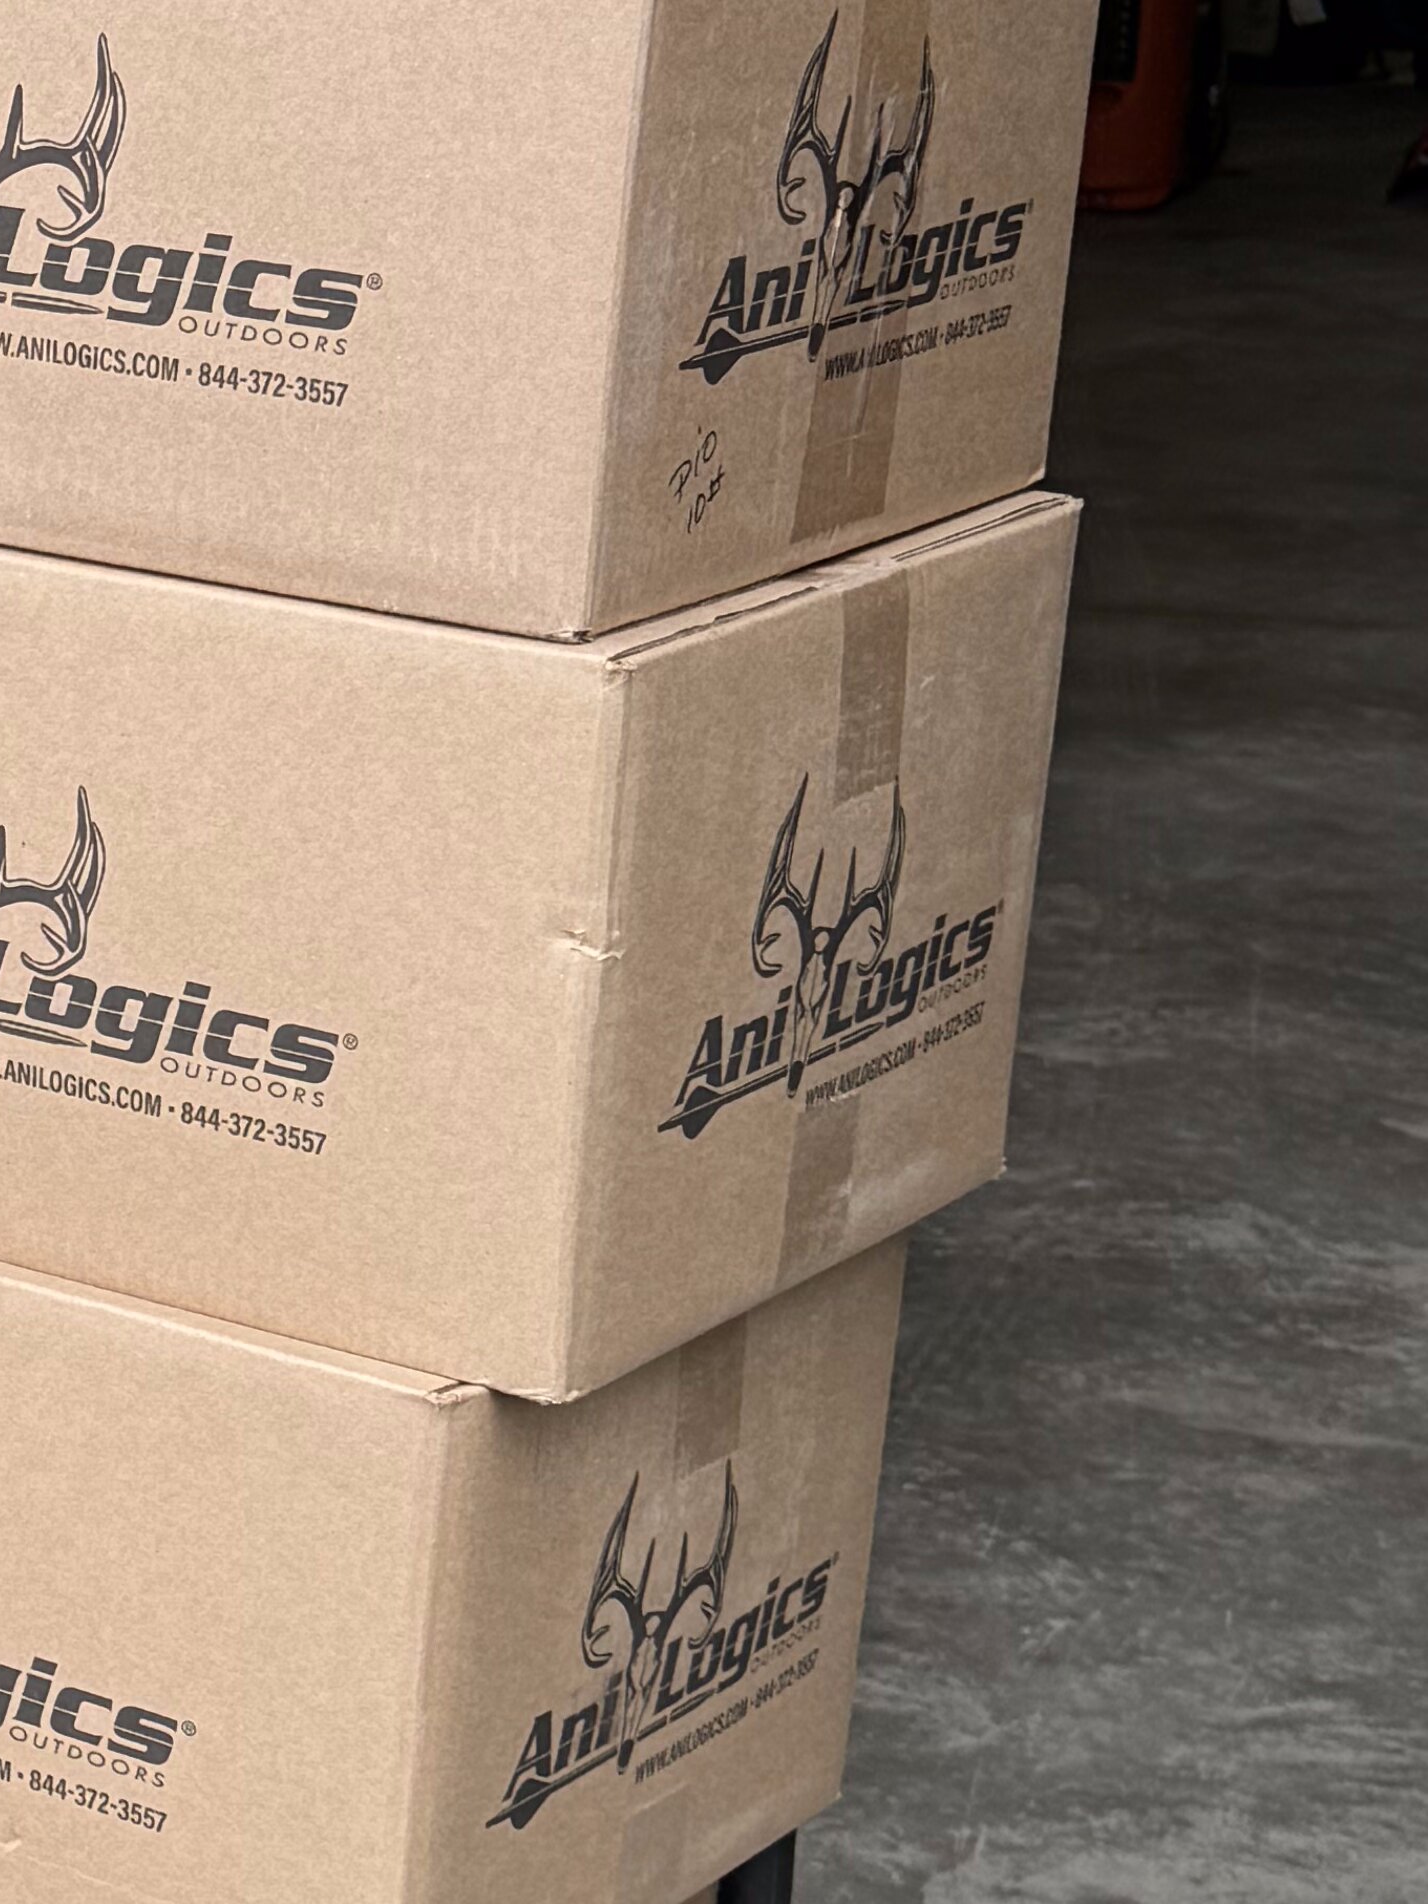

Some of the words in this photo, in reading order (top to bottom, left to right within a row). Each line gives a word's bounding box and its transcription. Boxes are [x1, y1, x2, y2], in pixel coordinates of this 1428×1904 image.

[697, 237, 814, 344] Ani
[940, 264, 1016, 301] OUTDOORS
[177, 314, 350, 357] OUTDOORS
[196, 360, 350, 410] 844-372-3557
[673, 987, 788, 1108] Ani
[158, 1055, 326, 1110] OUTDOORS
[179, 1099, 328, 1159] 844-372-3557
[9, 1724, 167, 1790] OUTDOORS
[501, 1669, 622, 1803] Ani
[27, 1768, 169, 1835] 844-372-3557
